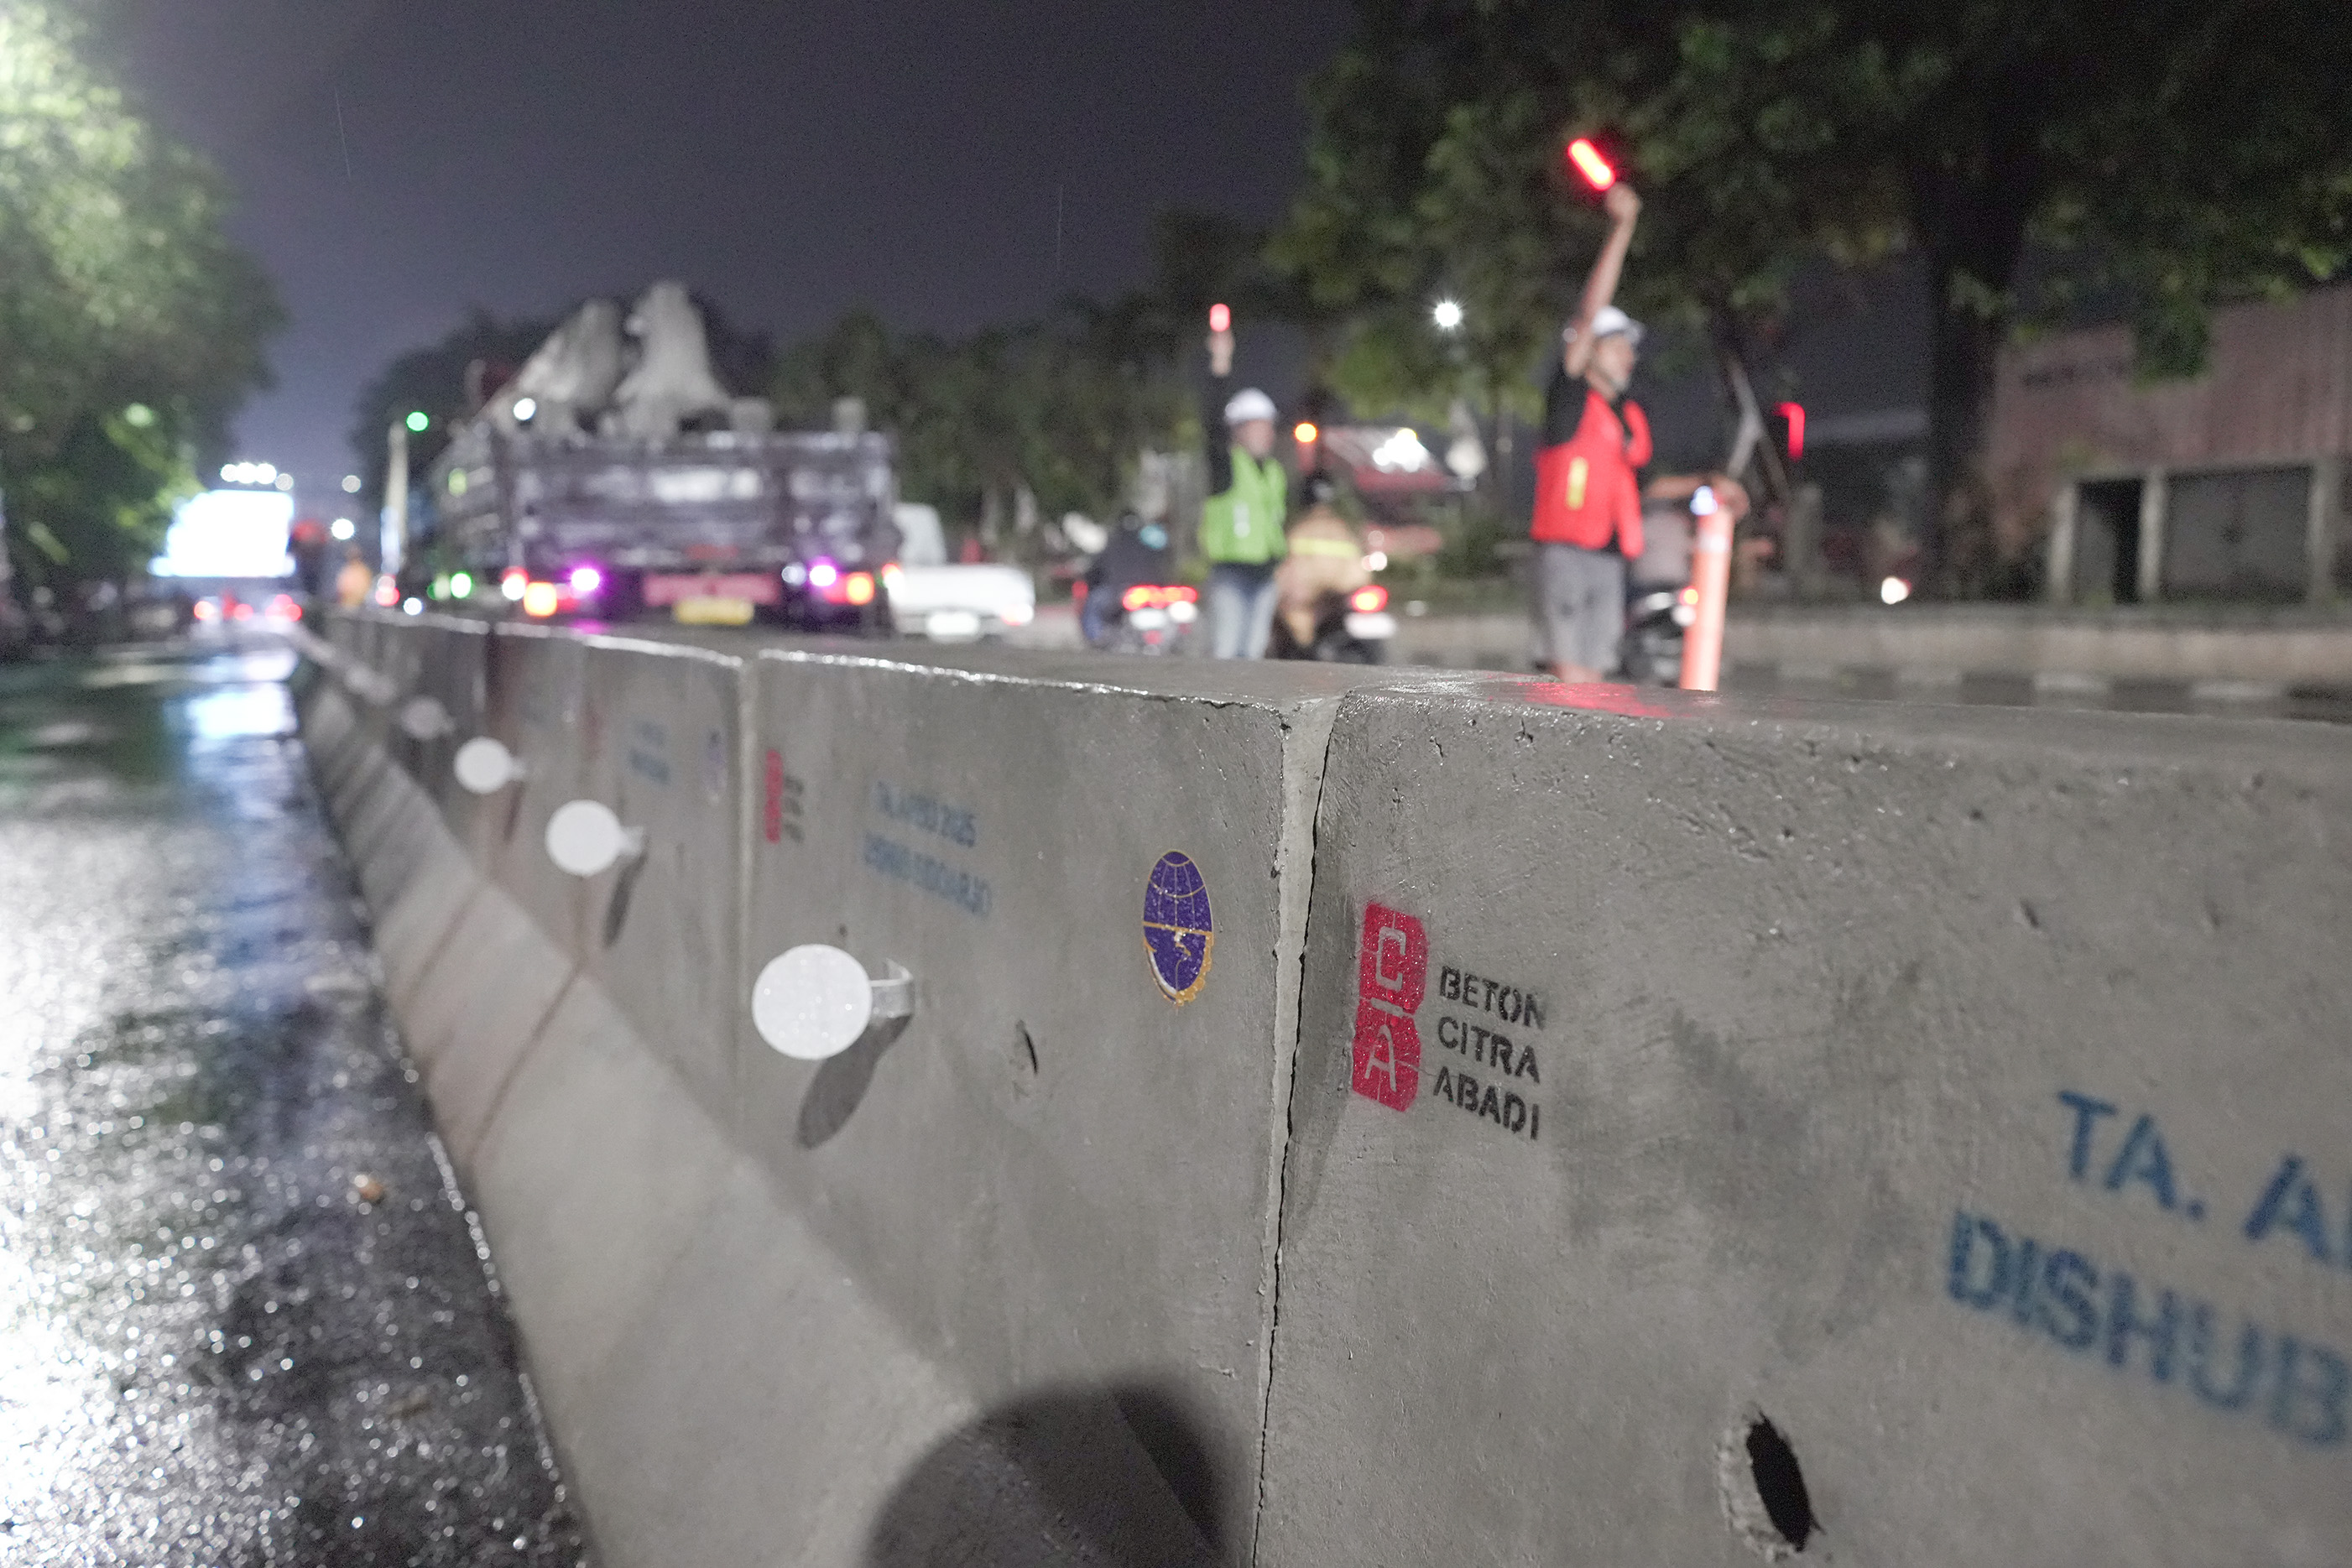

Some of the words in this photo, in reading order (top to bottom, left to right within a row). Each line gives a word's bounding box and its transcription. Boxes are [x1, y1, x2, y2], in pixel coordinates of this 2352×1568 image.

[1440, 966, 1544, 1029] BETON
[1437, 1016, 1541, 1084] CITRA
[1432, 1066, 1539, 1140] ABADI
[2058, 1090, 2204, 1222] TA.
[2244, 1154, 2352, 1268] A
[1948, 1211, 2352, 1445] DISHUB
